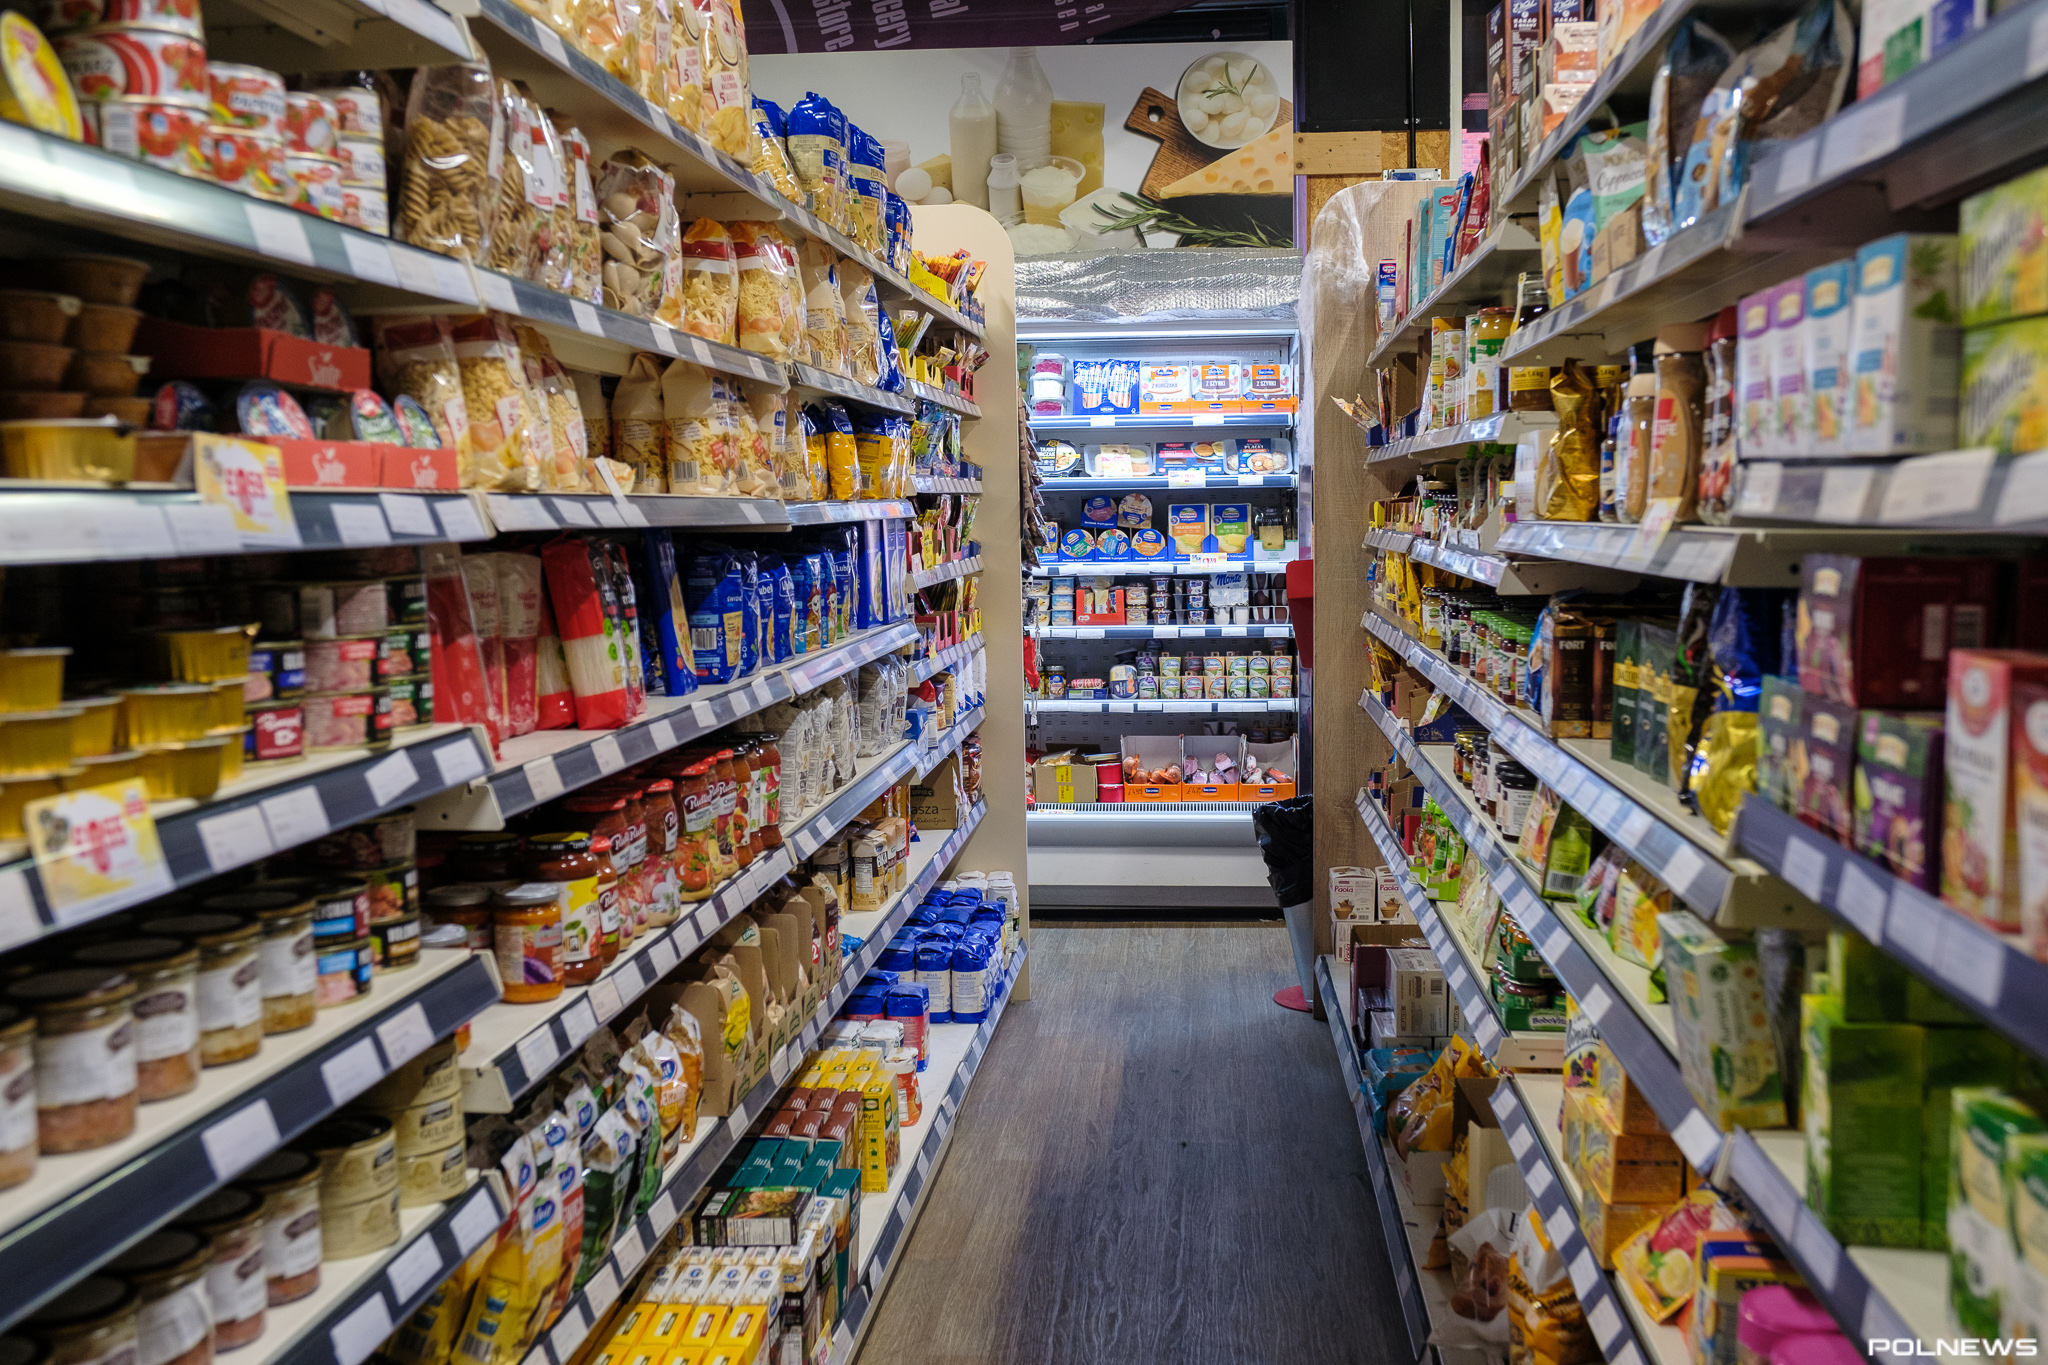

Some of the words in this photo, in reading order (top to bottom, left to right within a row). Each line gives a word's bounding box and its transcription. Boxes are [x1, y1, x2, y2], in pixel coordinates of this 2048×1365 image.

[871, 0, 912, 49] cery
[1215, 573, 1242, 586] Monte
[911, 805, 939, 815] asza
[1334, 885, 1354, 893] Paola
[1380, 884, 1399, 892] Paola
[828, 927, 836, 946] £2
